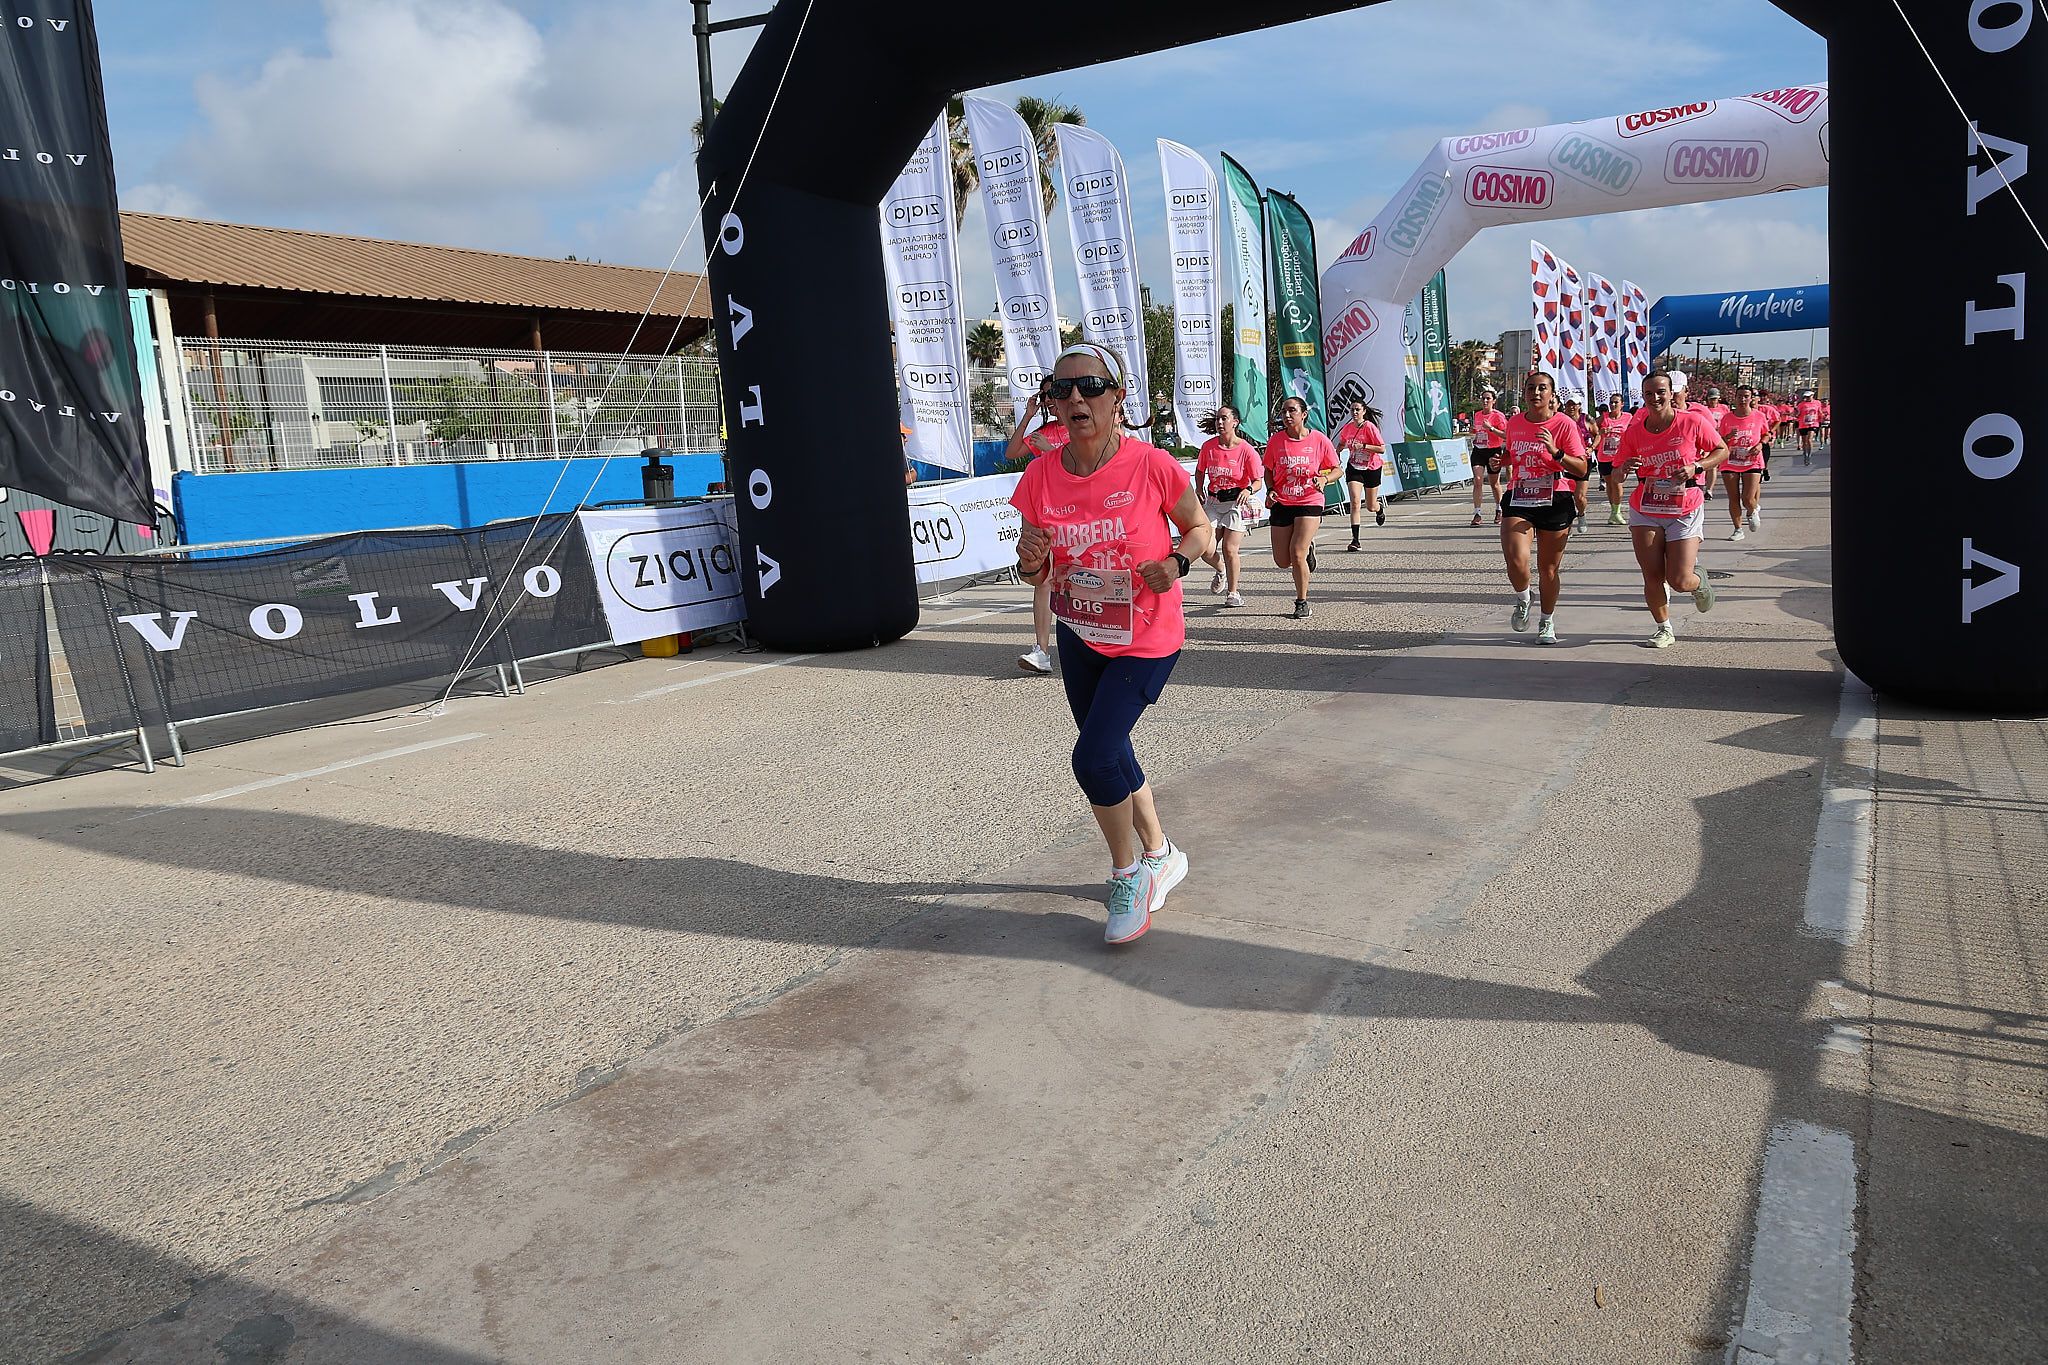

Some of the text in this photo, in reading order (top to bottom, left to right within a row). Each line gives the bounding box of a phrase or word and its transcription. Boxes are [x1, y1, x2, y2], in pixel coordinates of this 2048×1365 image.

[1625, 101, 1708, 131] COSMO
[1456, 129, 1529, 155] COSMO
[1557, 136, 1634, 190] COSMO
[1673, 145, 1760, 178] COSMO
[1472, 171, 1547, 205] COSMO
[1390, 179, 1446, 249] COSMO
[1718, 292, 1804, 328] Marlene
[1962, 0, 2033, 624] VOLVO
[720, 212, 781, 599] VOLVO
[1279, 456, 1311, 465] CARRERA
[1641, 449, 1682, 467] CARRERA
[1653, 493, 1670, 501] 016
[629, 544, 737, 592] ziaja
[117, 564, 562, 652] VOLVO
[1072, 598, 1104, 614] 016
